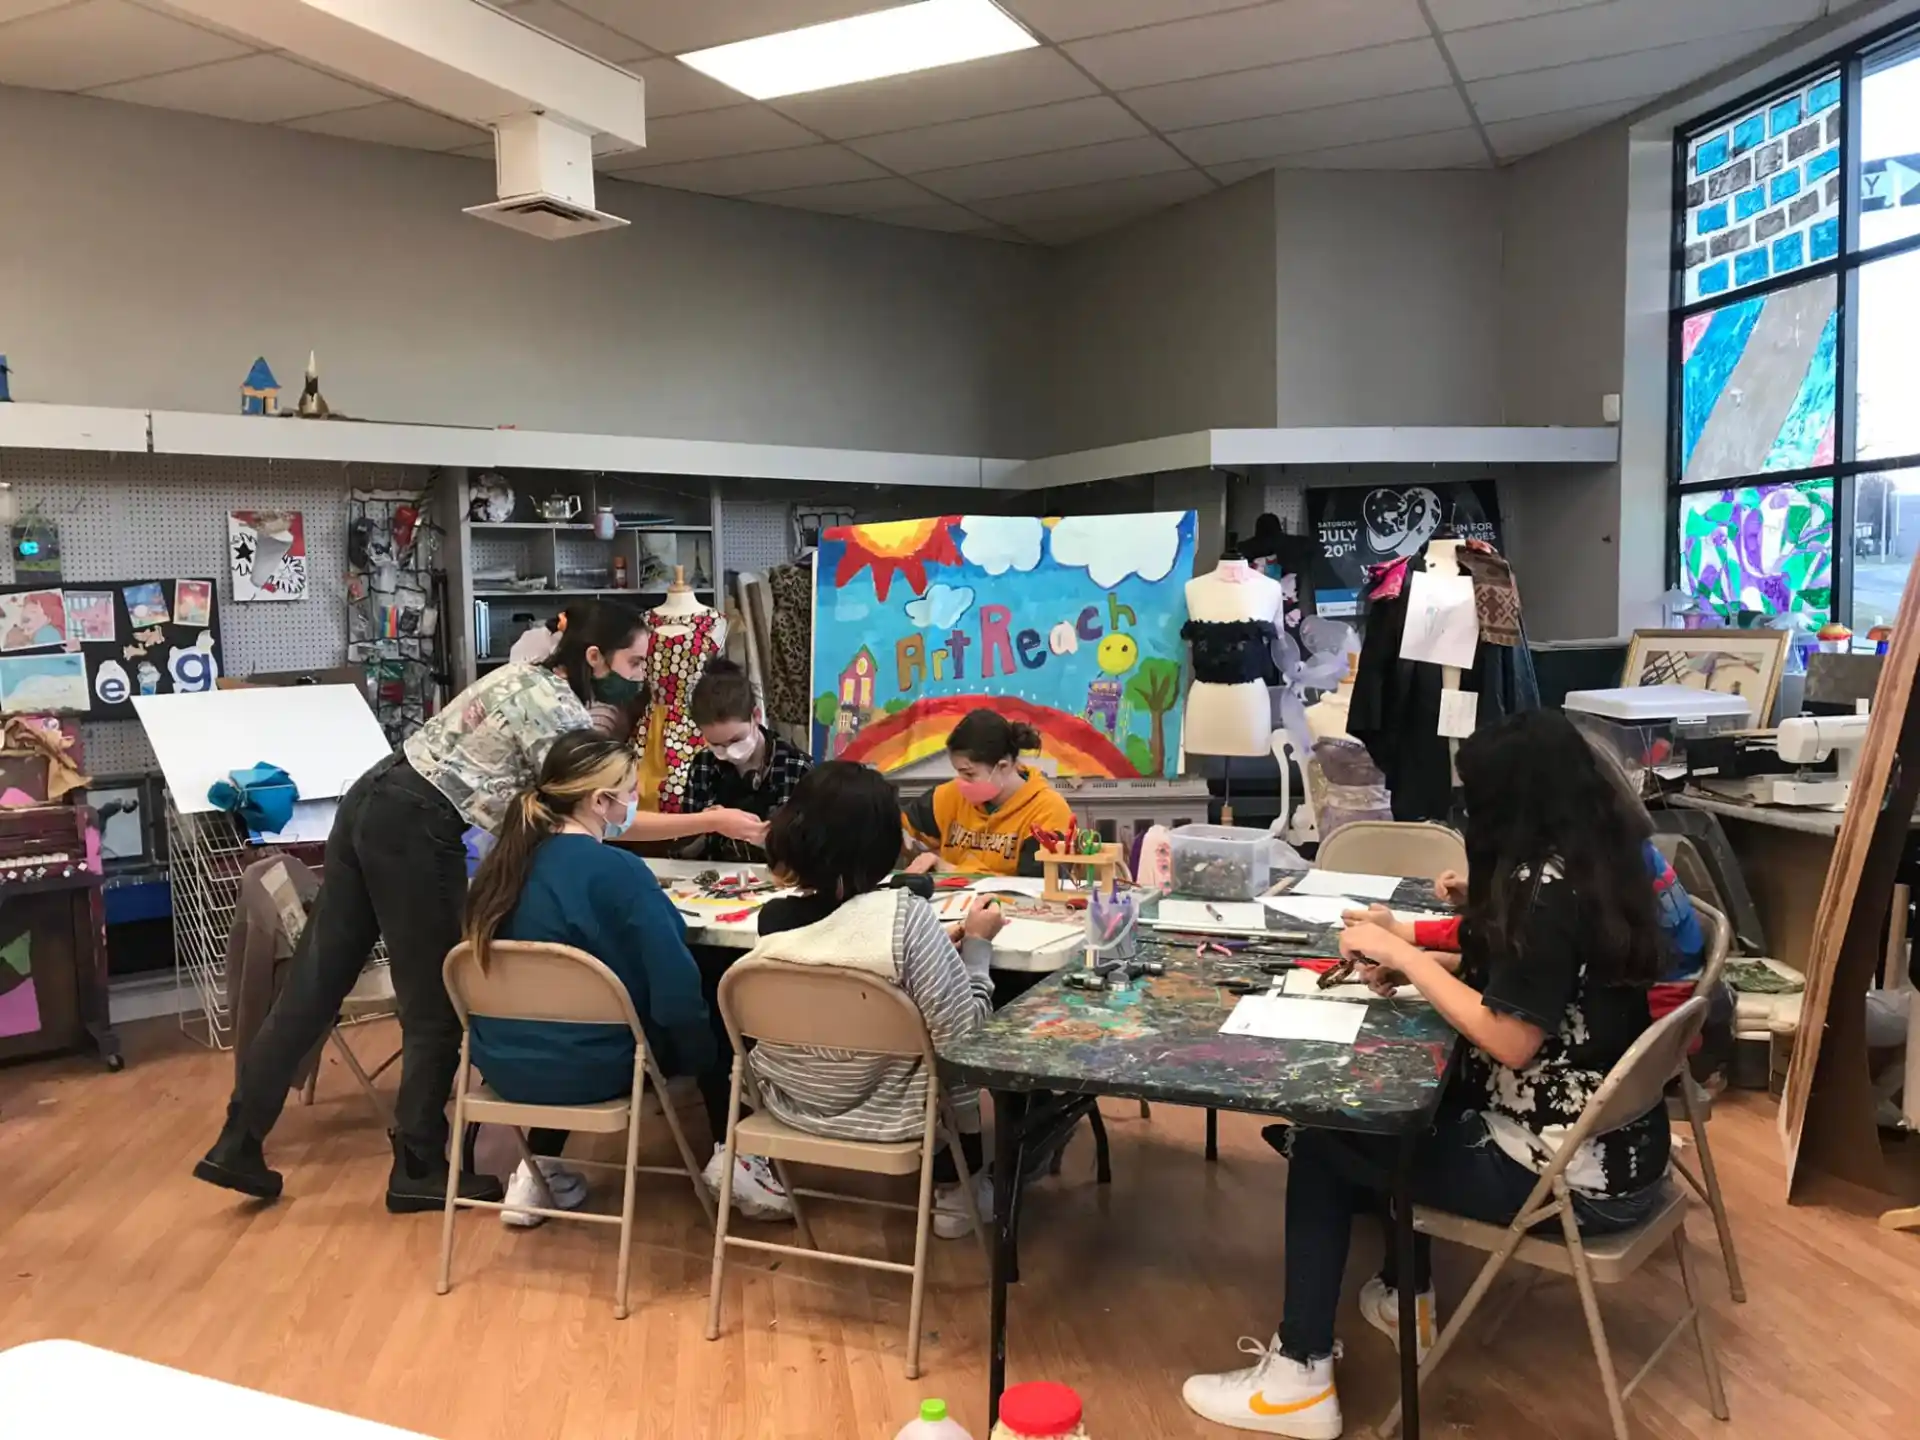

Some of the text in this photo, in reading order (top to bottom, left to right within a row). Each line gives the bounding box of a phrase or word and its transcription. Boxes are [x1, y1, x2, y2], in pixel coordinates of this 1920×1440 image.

[1470, 522, 1493, 531] FOR
[1318, 529, 1358, 543] JULY
[1323, 543, 1357, 558] 20TH
[100, 678, 125, 701] e
